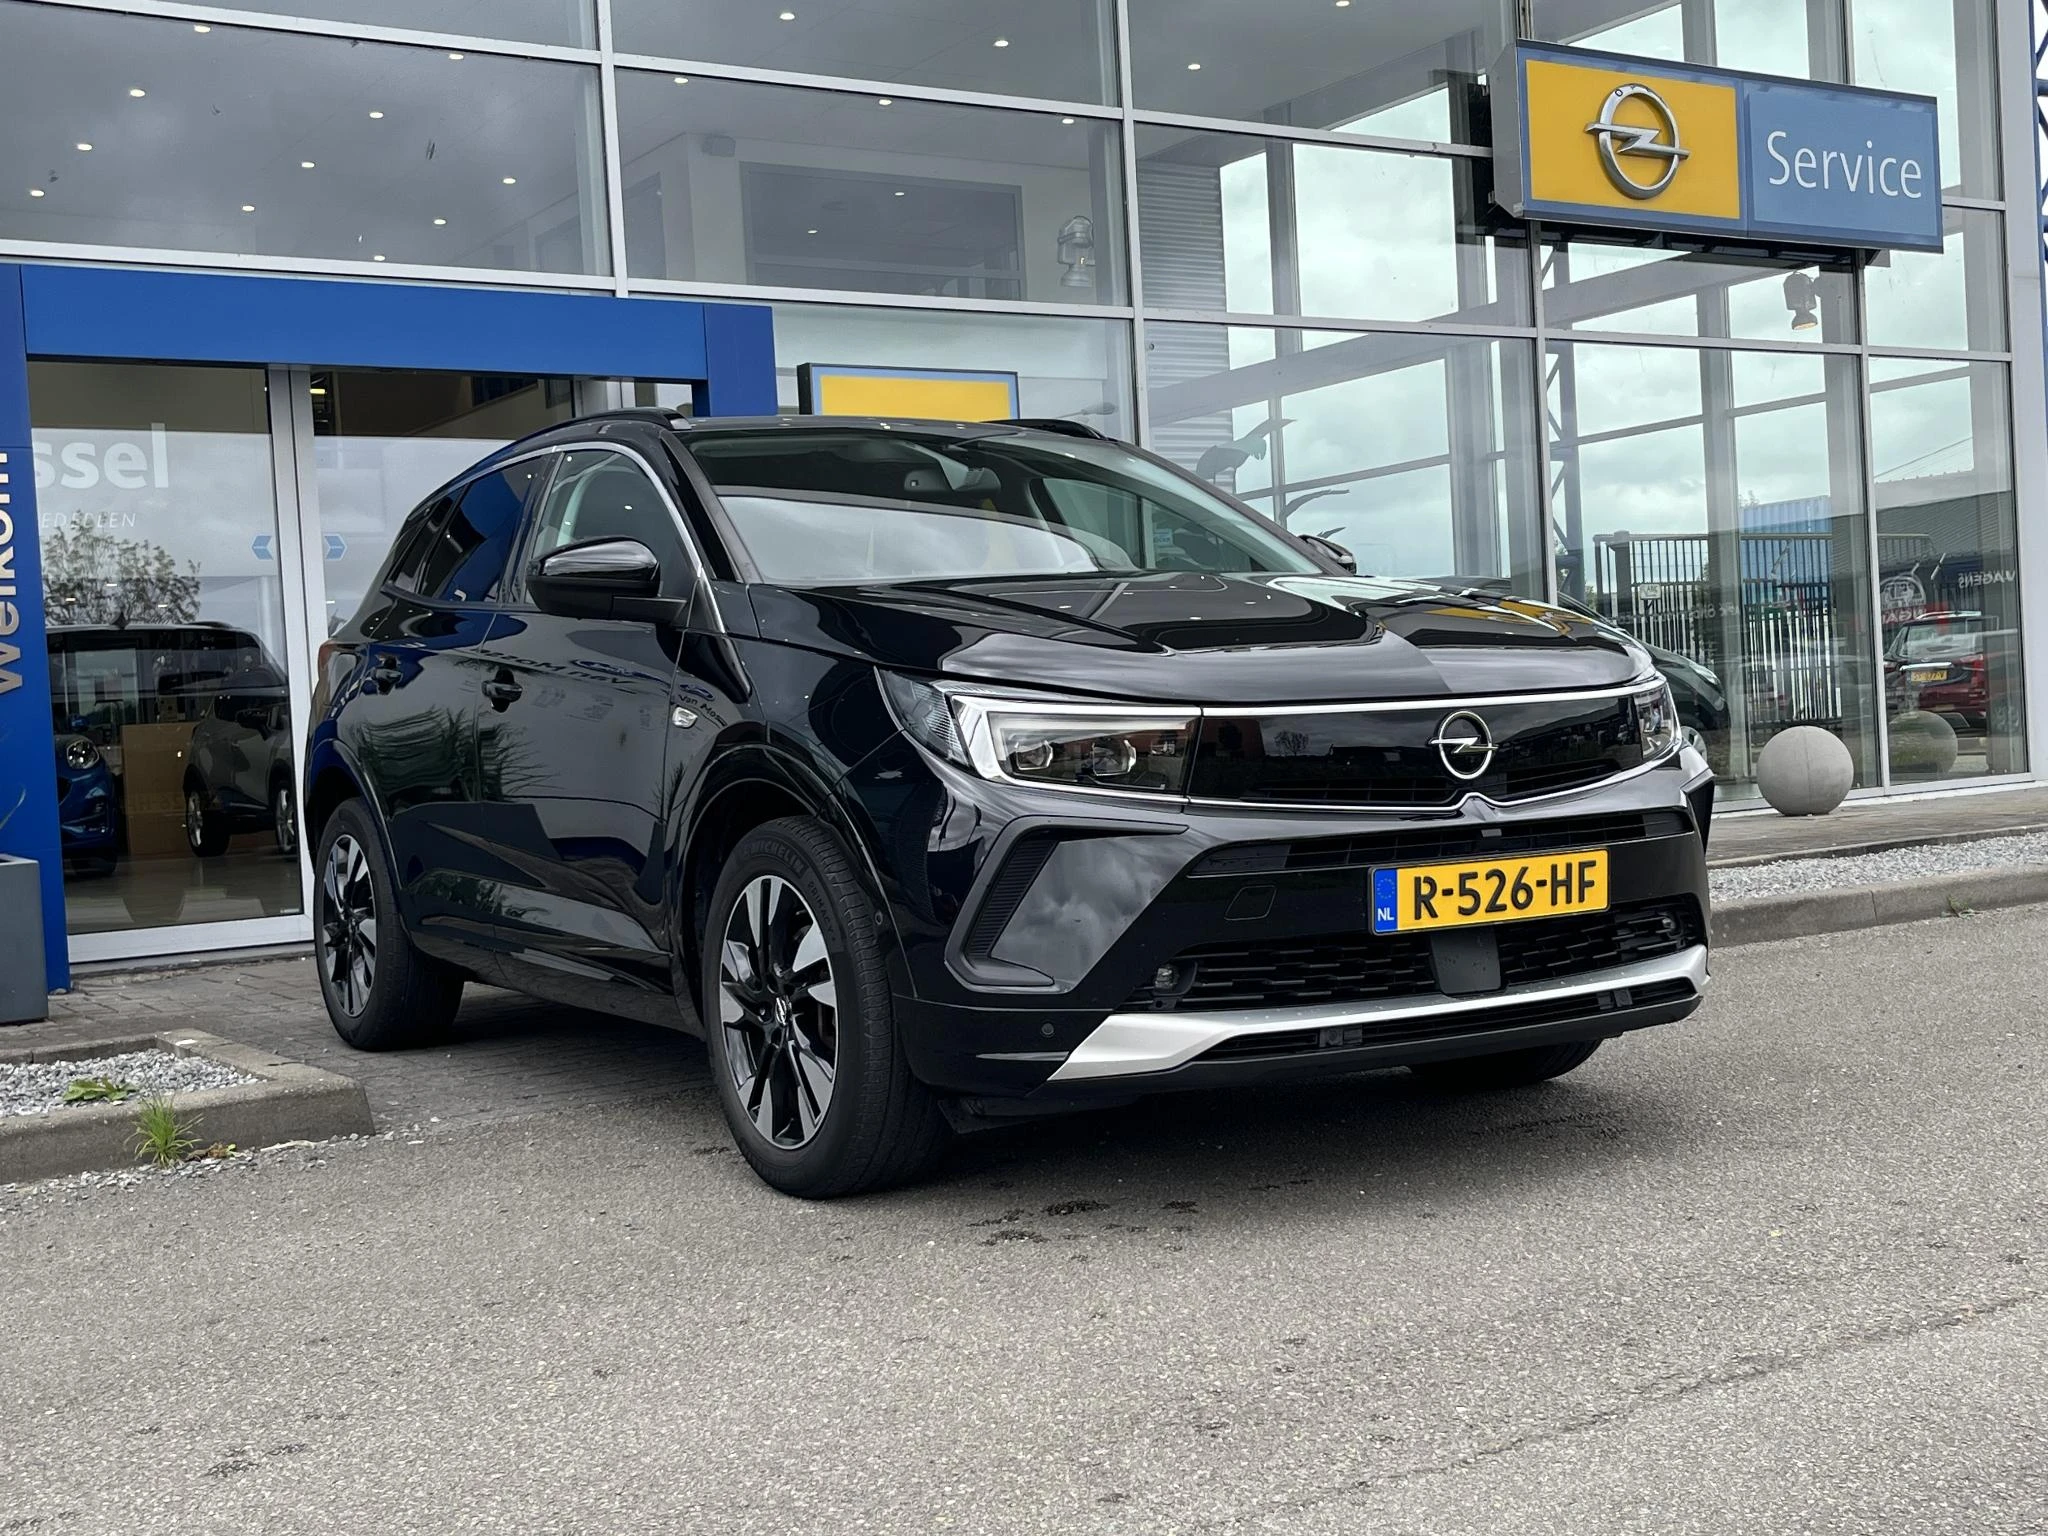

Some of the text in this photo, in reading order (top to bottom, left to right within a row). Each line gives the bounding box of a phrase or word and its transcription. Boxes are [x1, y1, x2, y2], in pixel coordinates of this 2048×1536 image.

[1766, 130, 1923, 199] Service
[0, 452, 24, 694] Weo
[1377, 907, 1395, 921] NL
[1413, 860, 1597, 921] R-526-HF
